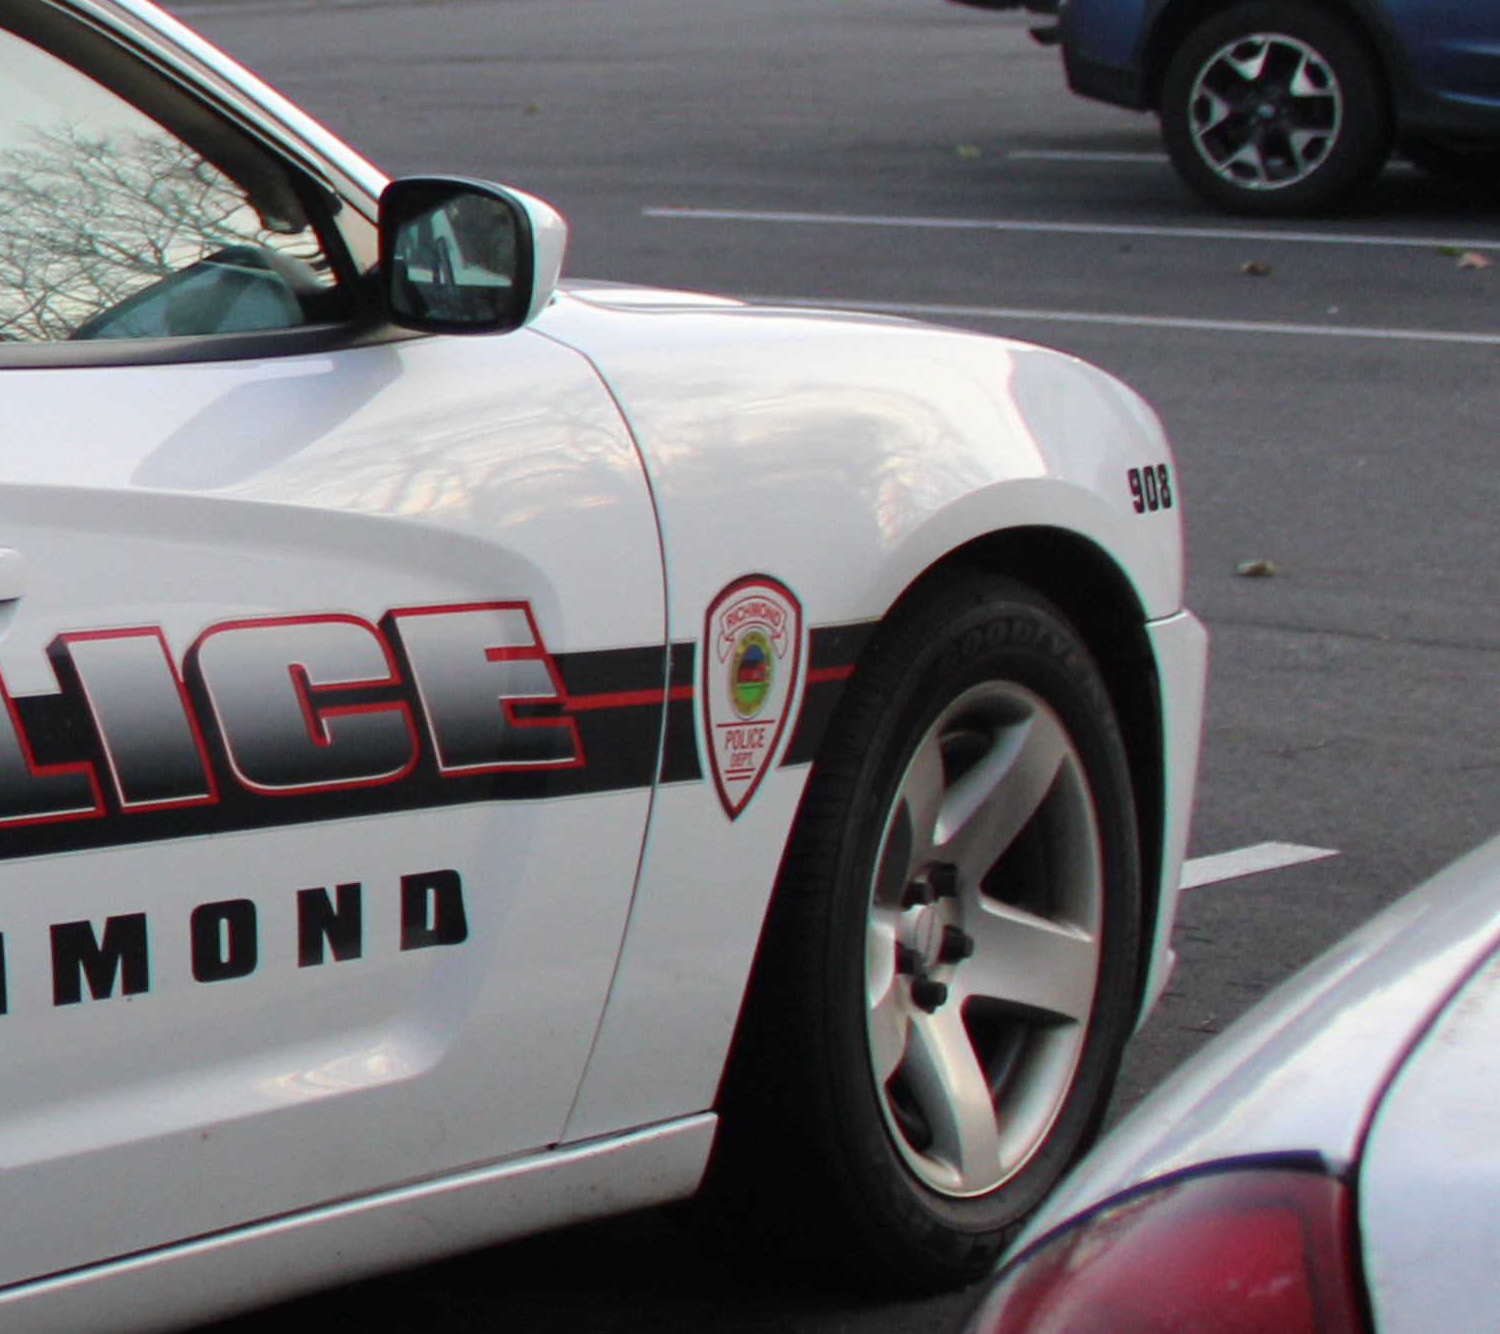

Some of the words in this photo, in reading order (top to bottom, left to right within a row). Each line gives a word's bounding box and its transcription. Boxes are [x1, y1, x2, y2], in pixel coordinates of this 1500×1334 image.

[1127, 464, 1172, 515] 908
[726, 600, 781, 627] RICHMOND
[725, 727, 766, 751] POLICE
